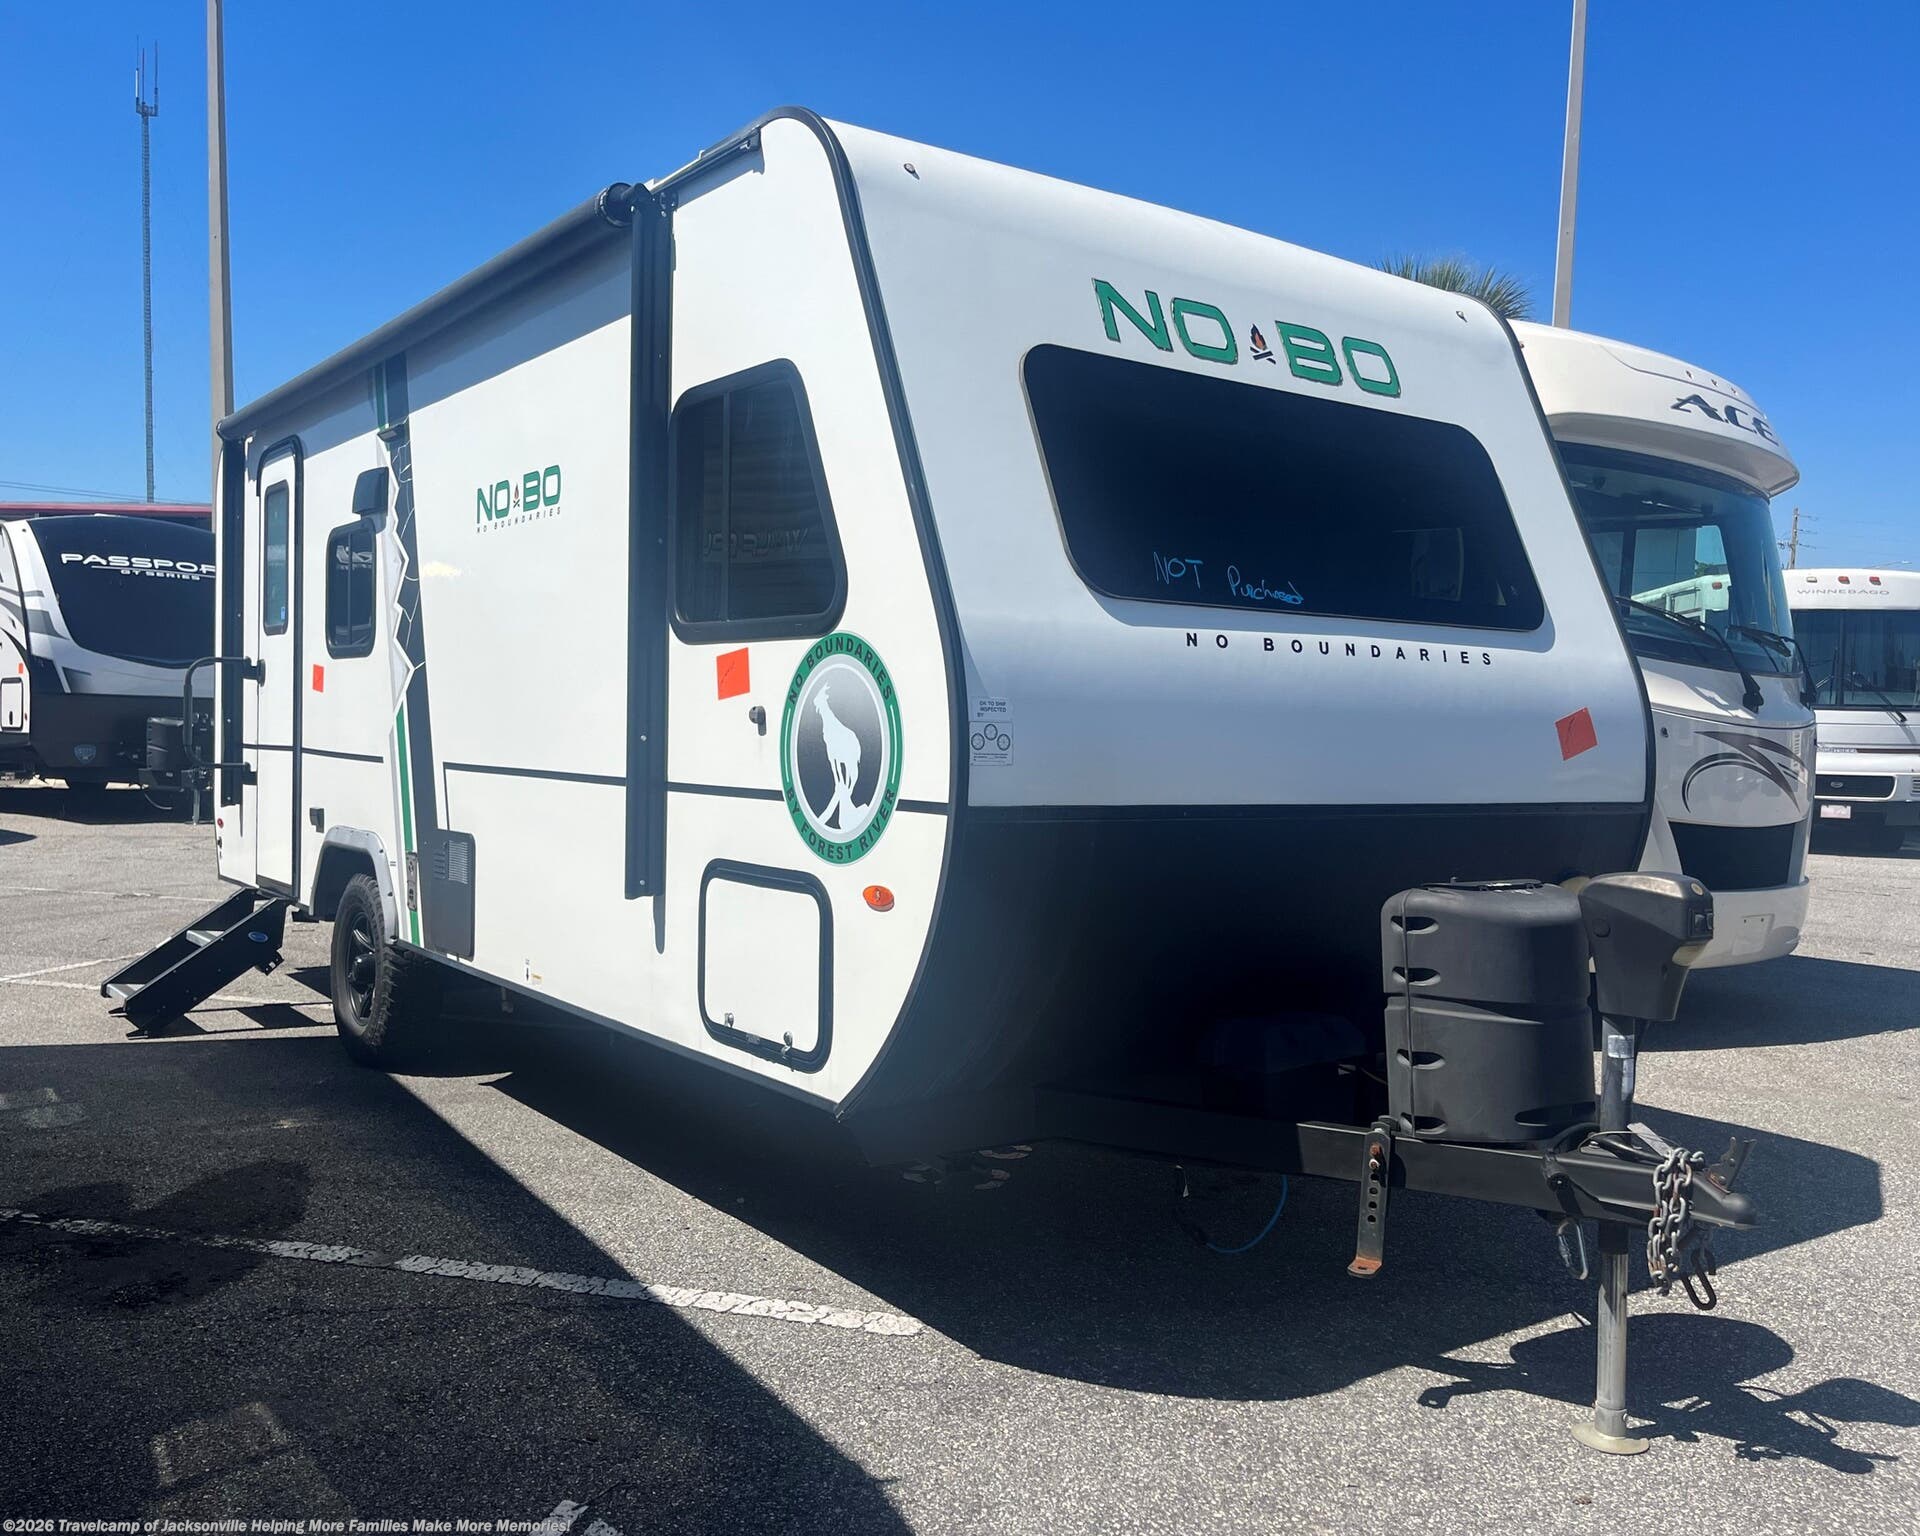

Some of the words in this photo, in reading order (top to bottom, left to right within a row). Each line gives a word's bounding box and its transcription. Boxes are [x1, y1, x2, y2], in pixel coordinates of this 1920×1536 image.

[494, 506, 561, 530] BOUNDARIES
[120, 568, 142, 576] GT
[145, 569, 201, 581] SERIES
[1153, 551, 1204, 589] NOT
[1797, 588, 1890, 596] WINNEBAGO
[1185, 632, 1229, 649] NO
[1263, 637, 1492, 666] BOUNDARIES
[788, 673, 804, 705] NO
[805, 636, 892, 700] BOUNDARIES
[786, 786, 801, 815] BY
[800, 821, 853, 860] FOREST
[859, 787, 896, 852] RIVER
